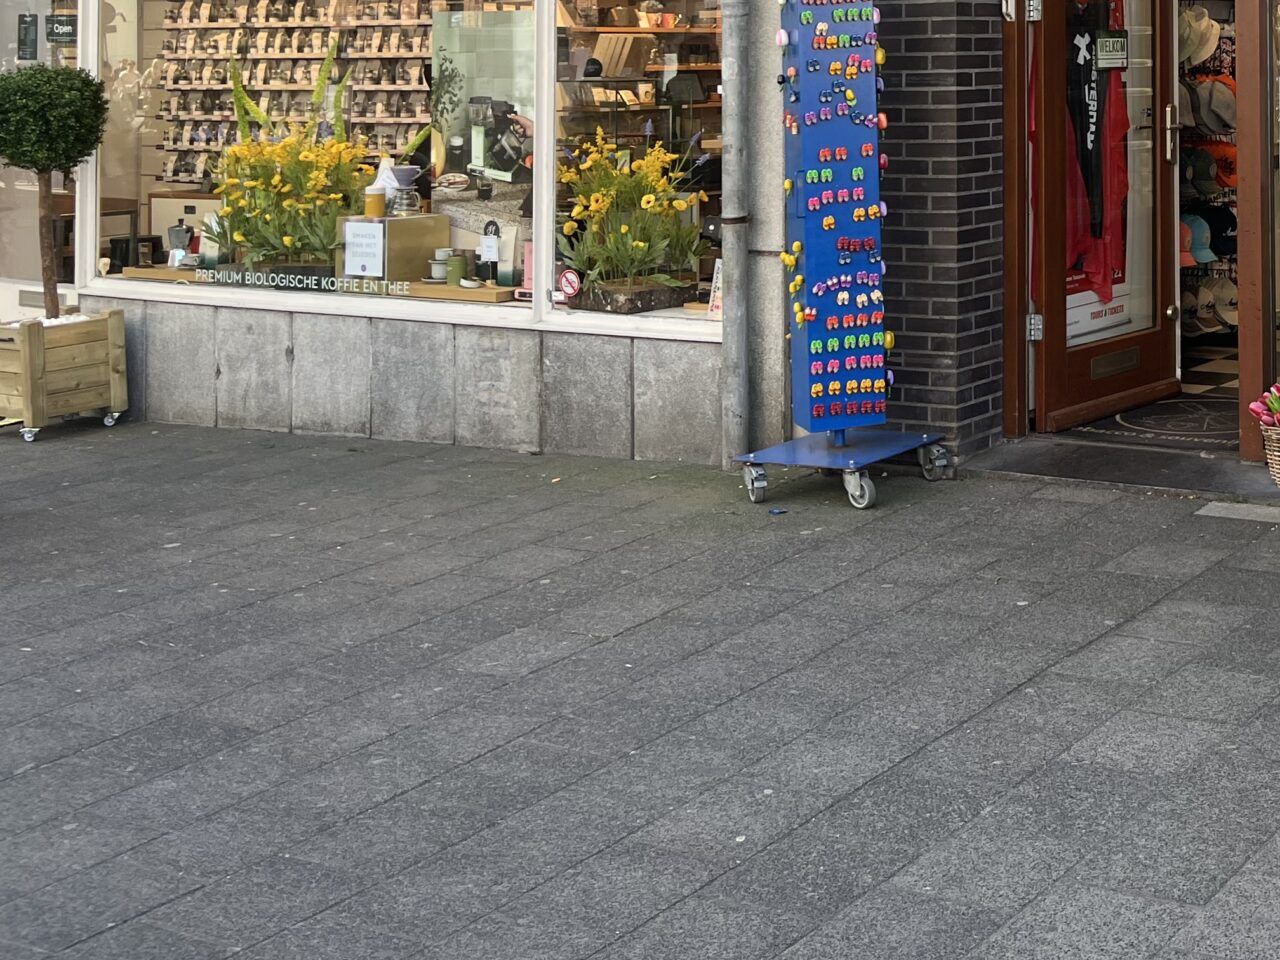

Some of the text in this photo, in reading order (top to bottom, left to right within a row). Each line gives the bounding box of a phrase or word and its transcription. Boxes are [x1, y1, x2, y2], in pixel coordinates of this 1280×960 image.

[54, 24, 73, 34] Open
[1099, 40, 1126, 53] WELKOM
[195, 268, 410, 294] PREMIUM BIOLOGISCHE KOFFIE EN THEE
